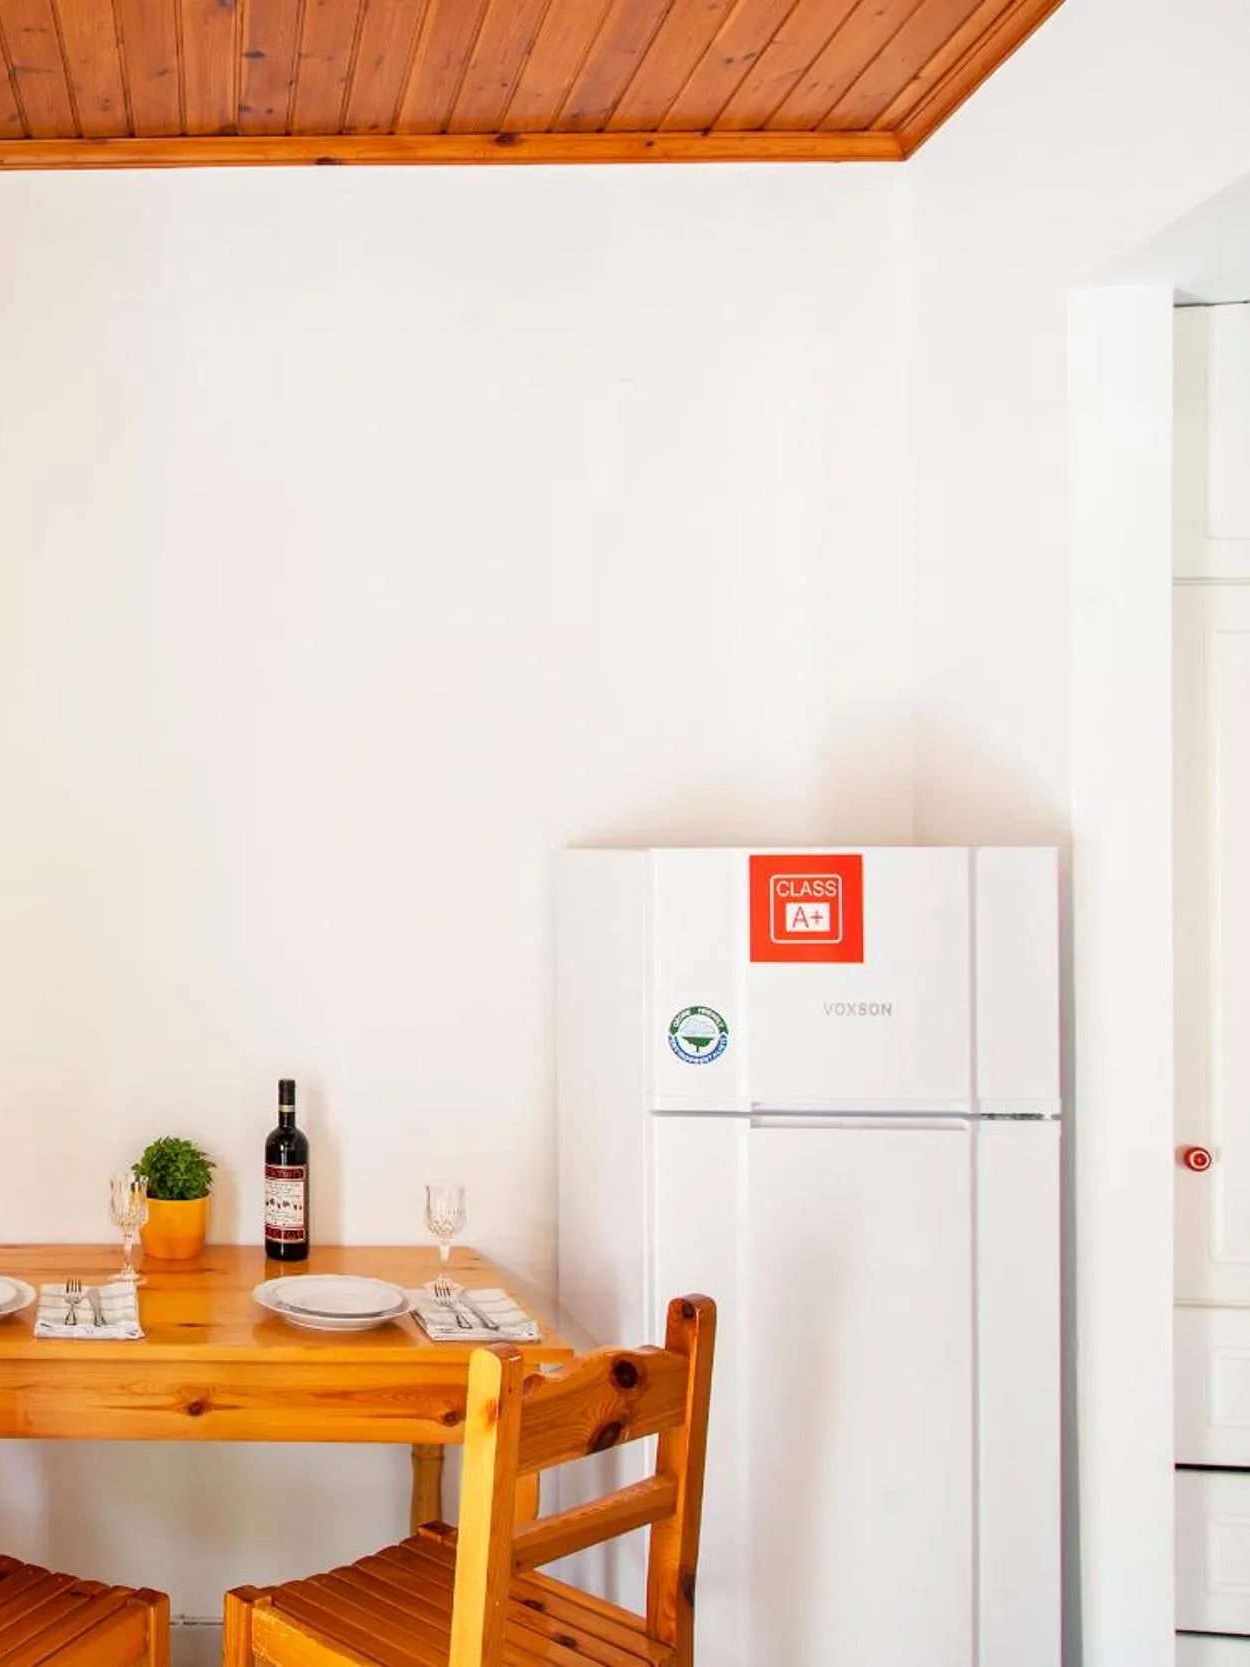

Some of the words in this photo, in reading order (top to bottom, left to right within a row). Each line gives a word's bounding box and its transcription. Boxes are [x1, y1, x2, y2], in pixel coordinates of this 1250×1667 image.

[776, 880, 837, 897] CLASS
[792, 906, 823, 929] A+
[823, 1002, 893, 1016] VOXSON
